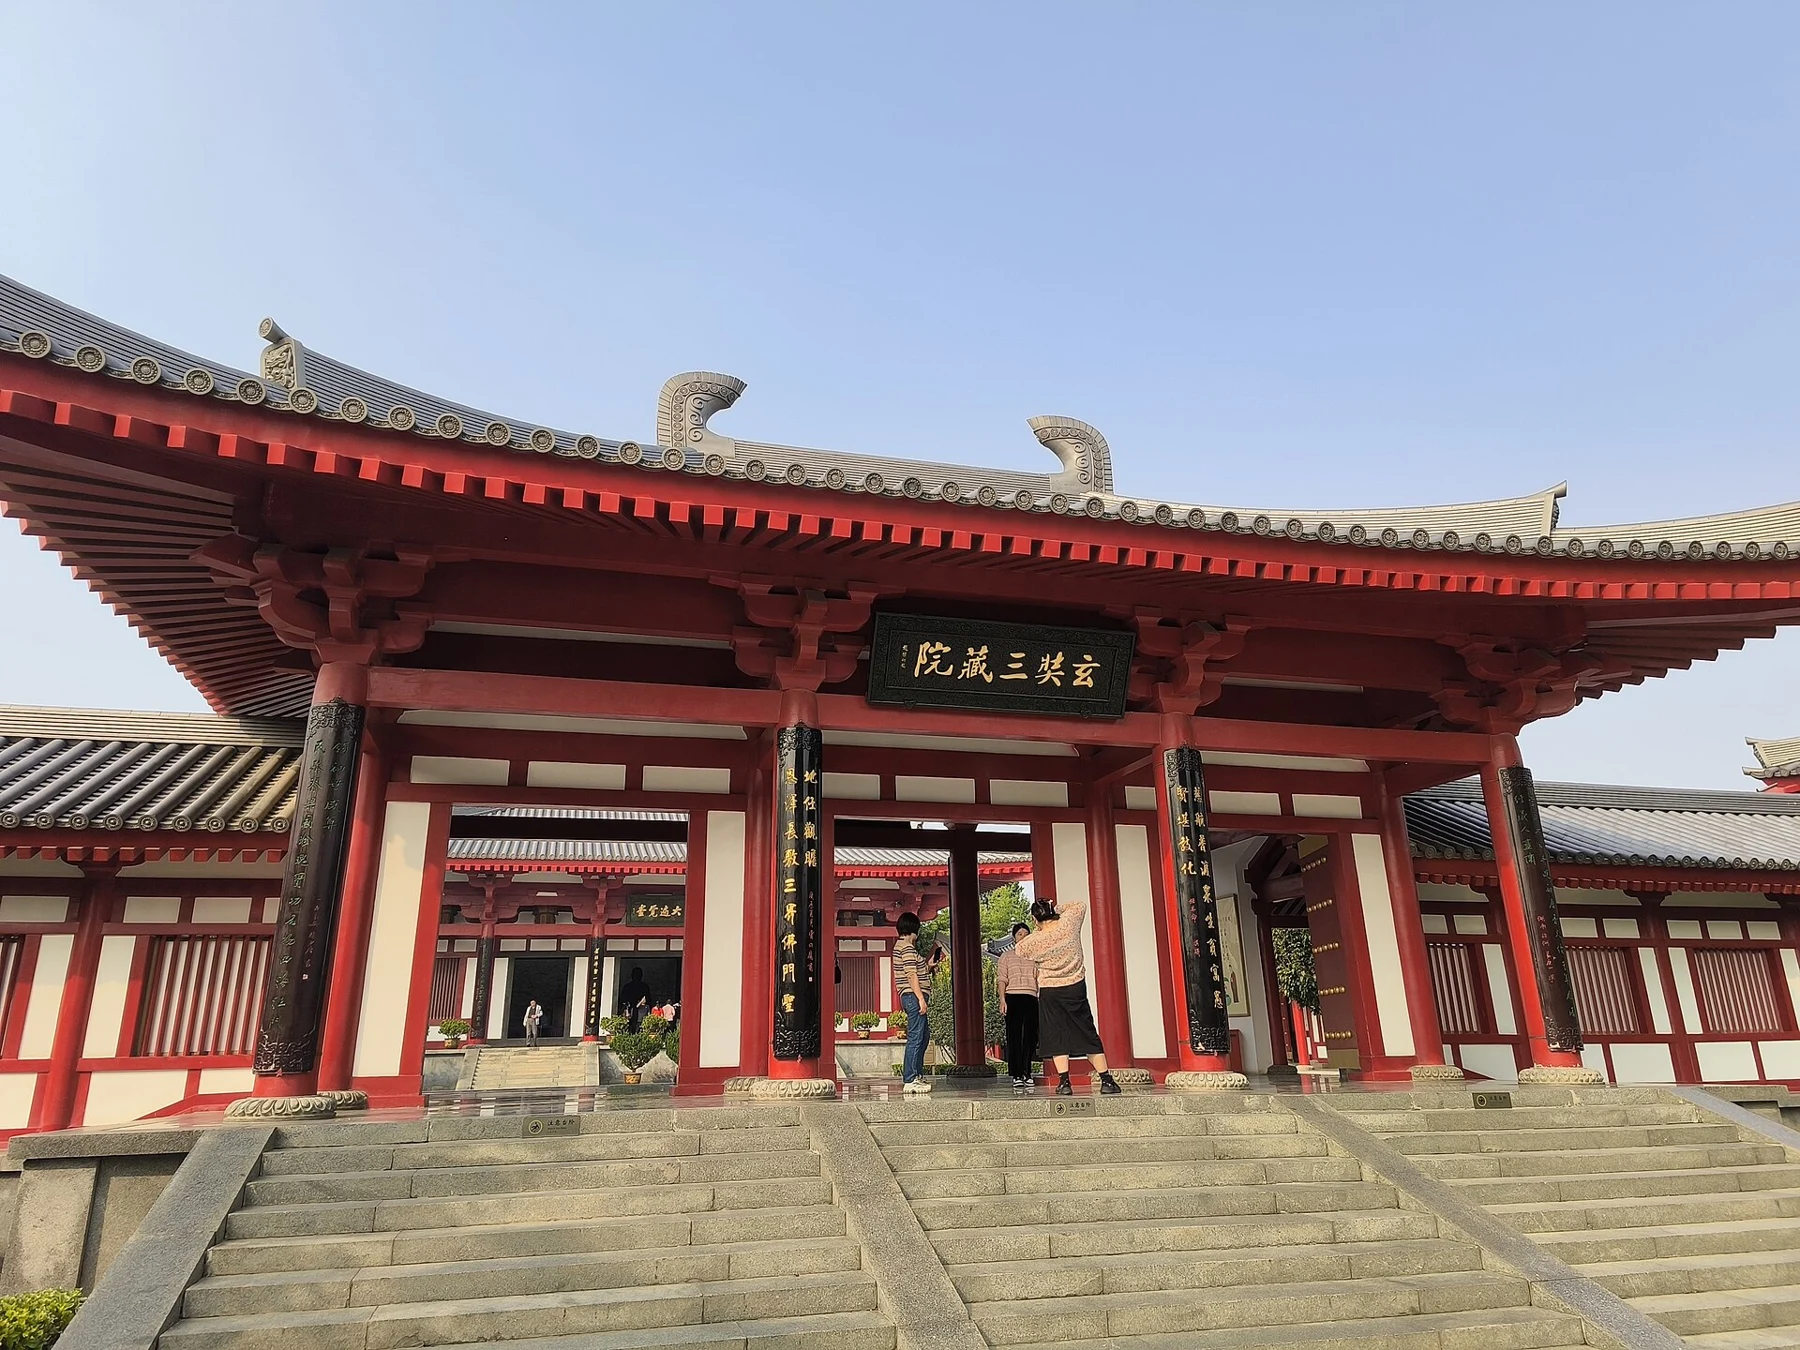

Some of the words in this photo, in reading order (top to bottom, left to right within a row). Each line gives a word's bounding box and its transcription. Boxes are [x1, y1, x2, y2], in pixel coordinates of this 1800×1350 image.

[913, 640, 1102, 688] 玄奘三藏院
